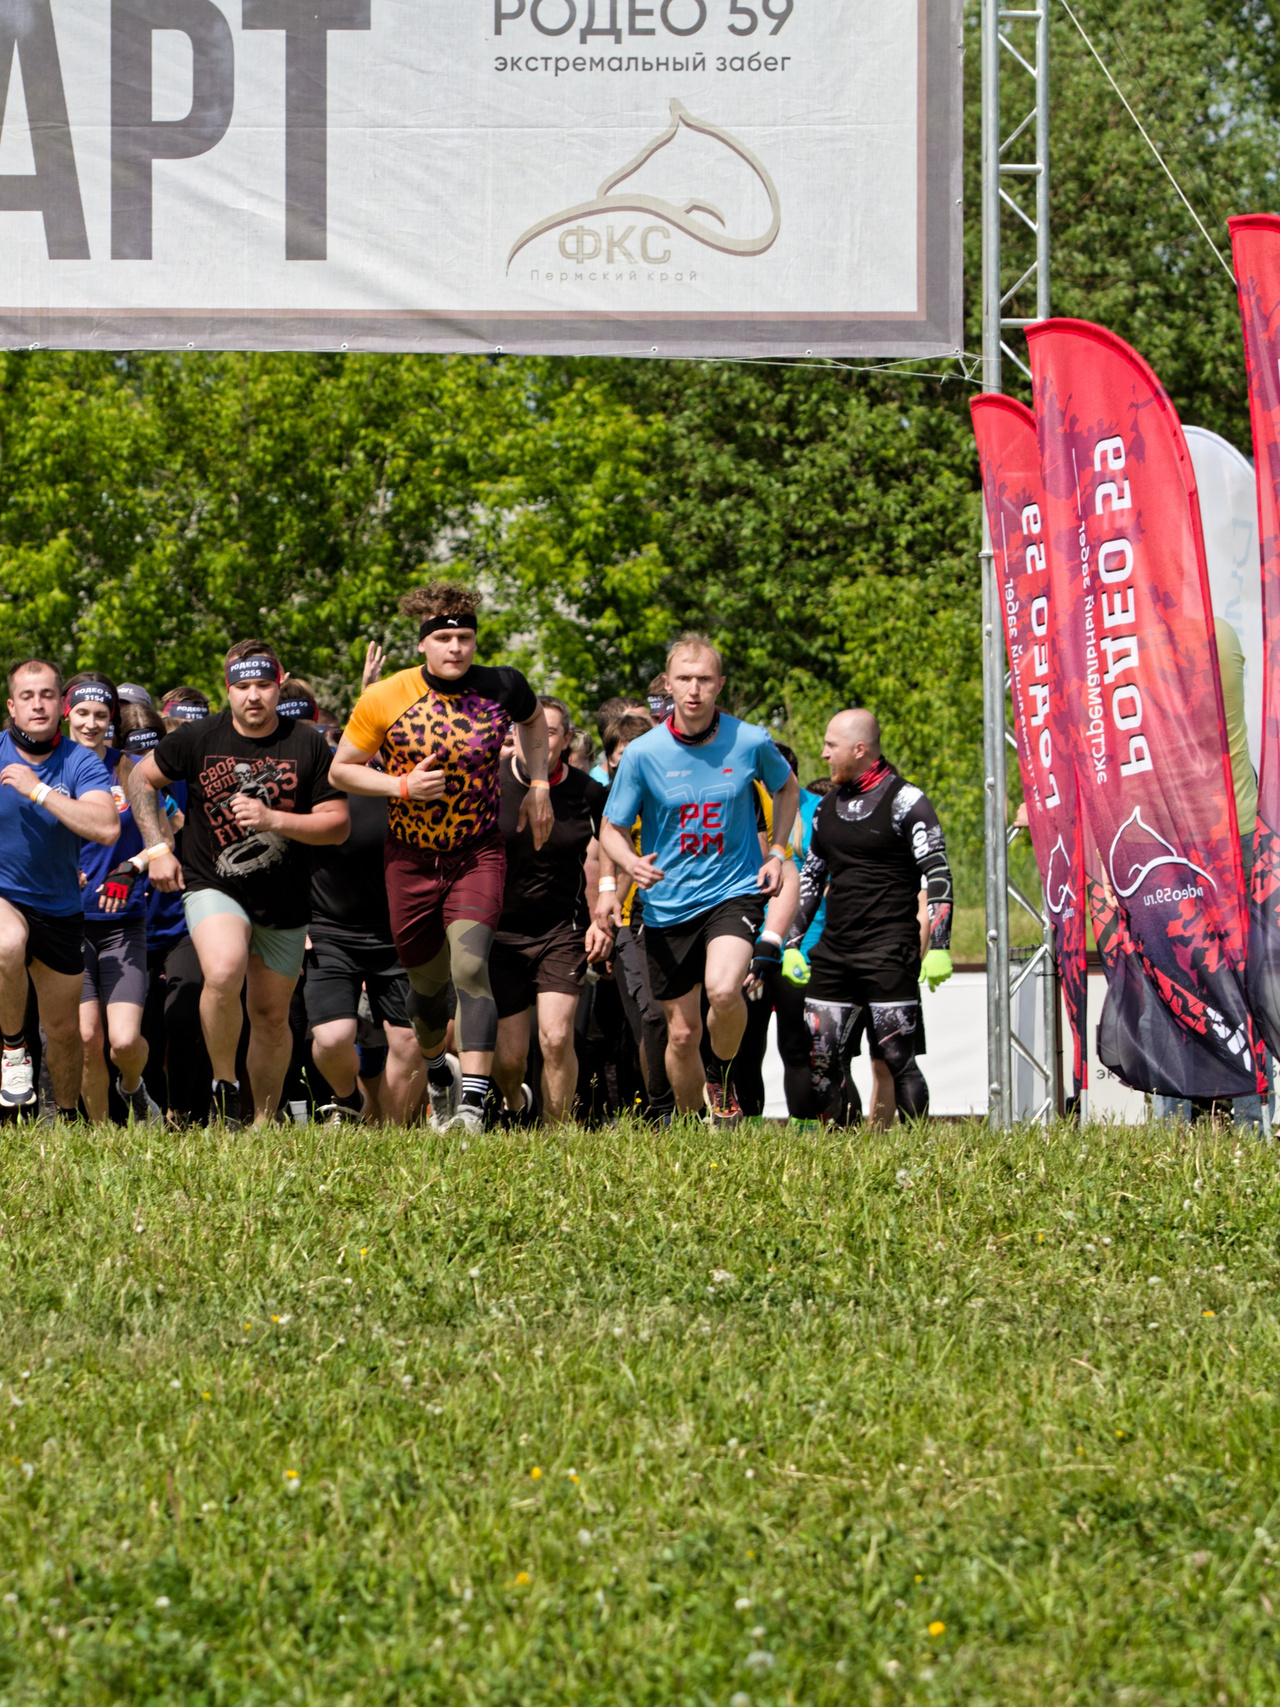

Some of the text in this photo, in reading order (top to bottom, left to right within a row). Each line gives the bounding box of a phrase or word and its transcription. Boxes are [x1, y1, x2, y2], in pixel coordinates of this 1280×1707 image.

[493, 0, 794, 44] РОДЕО 59
[493, 51, 791, 77] экстремальный забег
[558, 225, 671, 265] ФКС
[530, 269, 698, 283] Пермский край
[230, 661, 259, 673] РОДЕО
[239, 669, 262, 678] 2255
[276, 701, 298, 711] ОДЕО
[199, 756, 237, 786] СВОЯ
